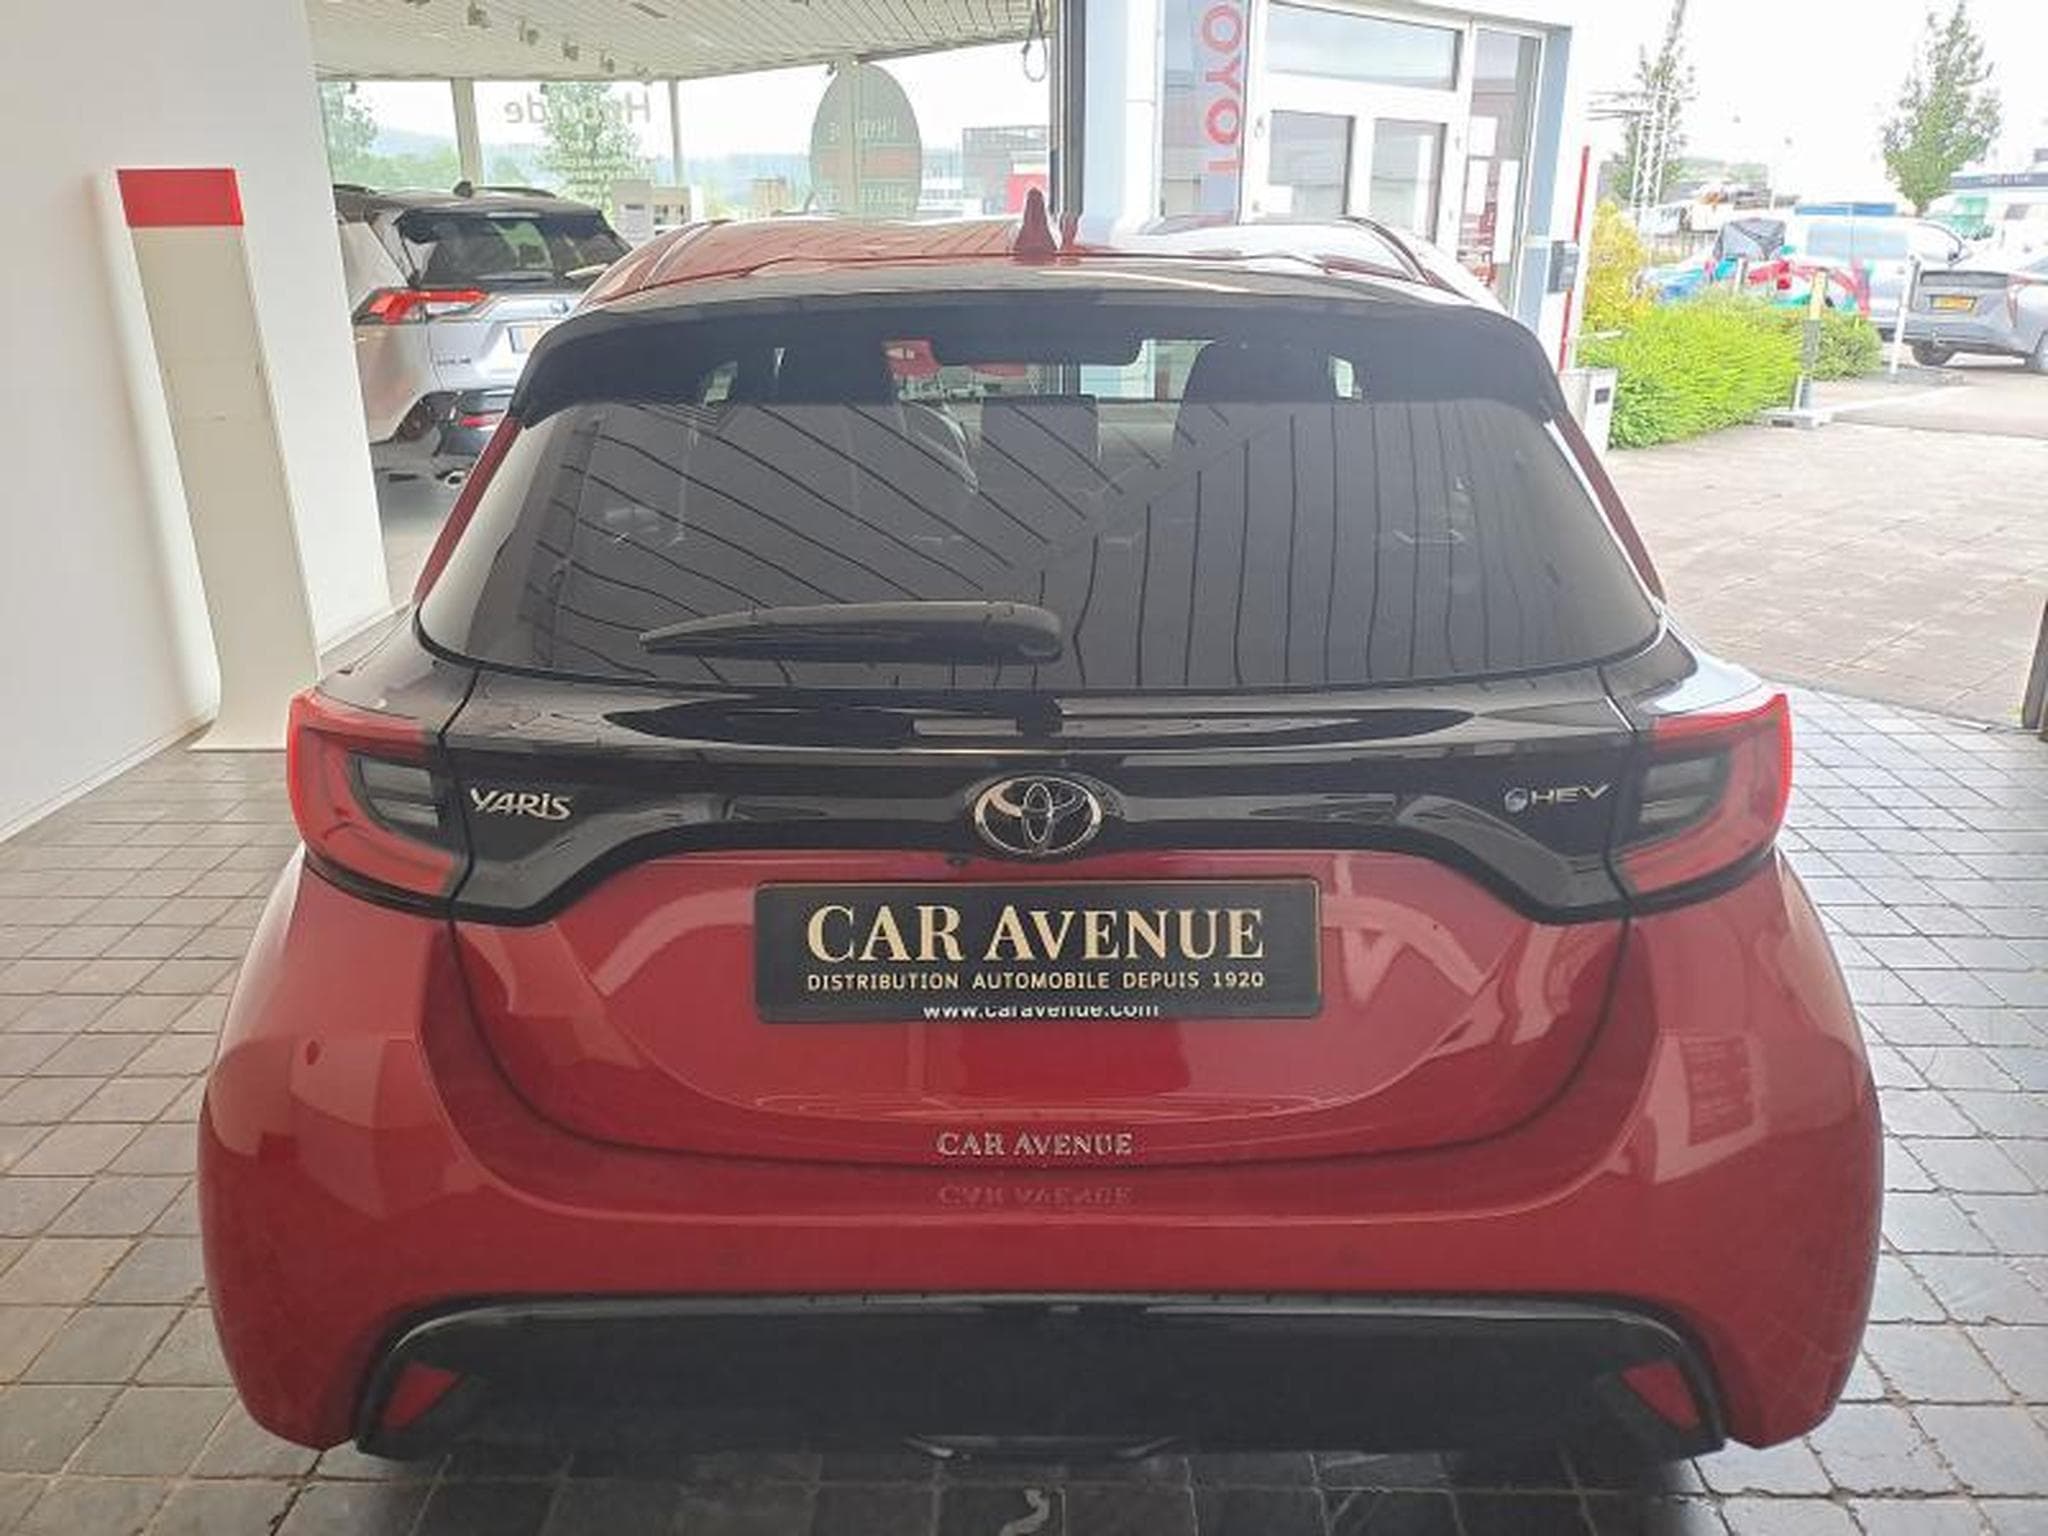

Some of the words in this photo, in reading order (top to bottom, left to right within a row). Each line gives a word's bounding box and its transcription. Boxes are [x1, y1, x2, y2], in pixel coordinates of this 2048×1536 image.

[469, 788, 571, 820] YARIS
[1531, 783, 1610, 804] HEV
[807, 904, 964, 963] CAR
[982, 904, 1264, 962] AVENUE
[807, 974, 959, 991] DISTRIBUTION
[972, 972, 1110, 990] AUTOMOBILE
[1122, 971, 1200, 989] DEPUIS
[1212, 971, 1264, 988] 1920
[922, 1005, 1159, 1019] www.caravenue.com
[936, 1132, 1005, 1156] CAR
[1013, 1133, 1133, 1156] AVENUE
